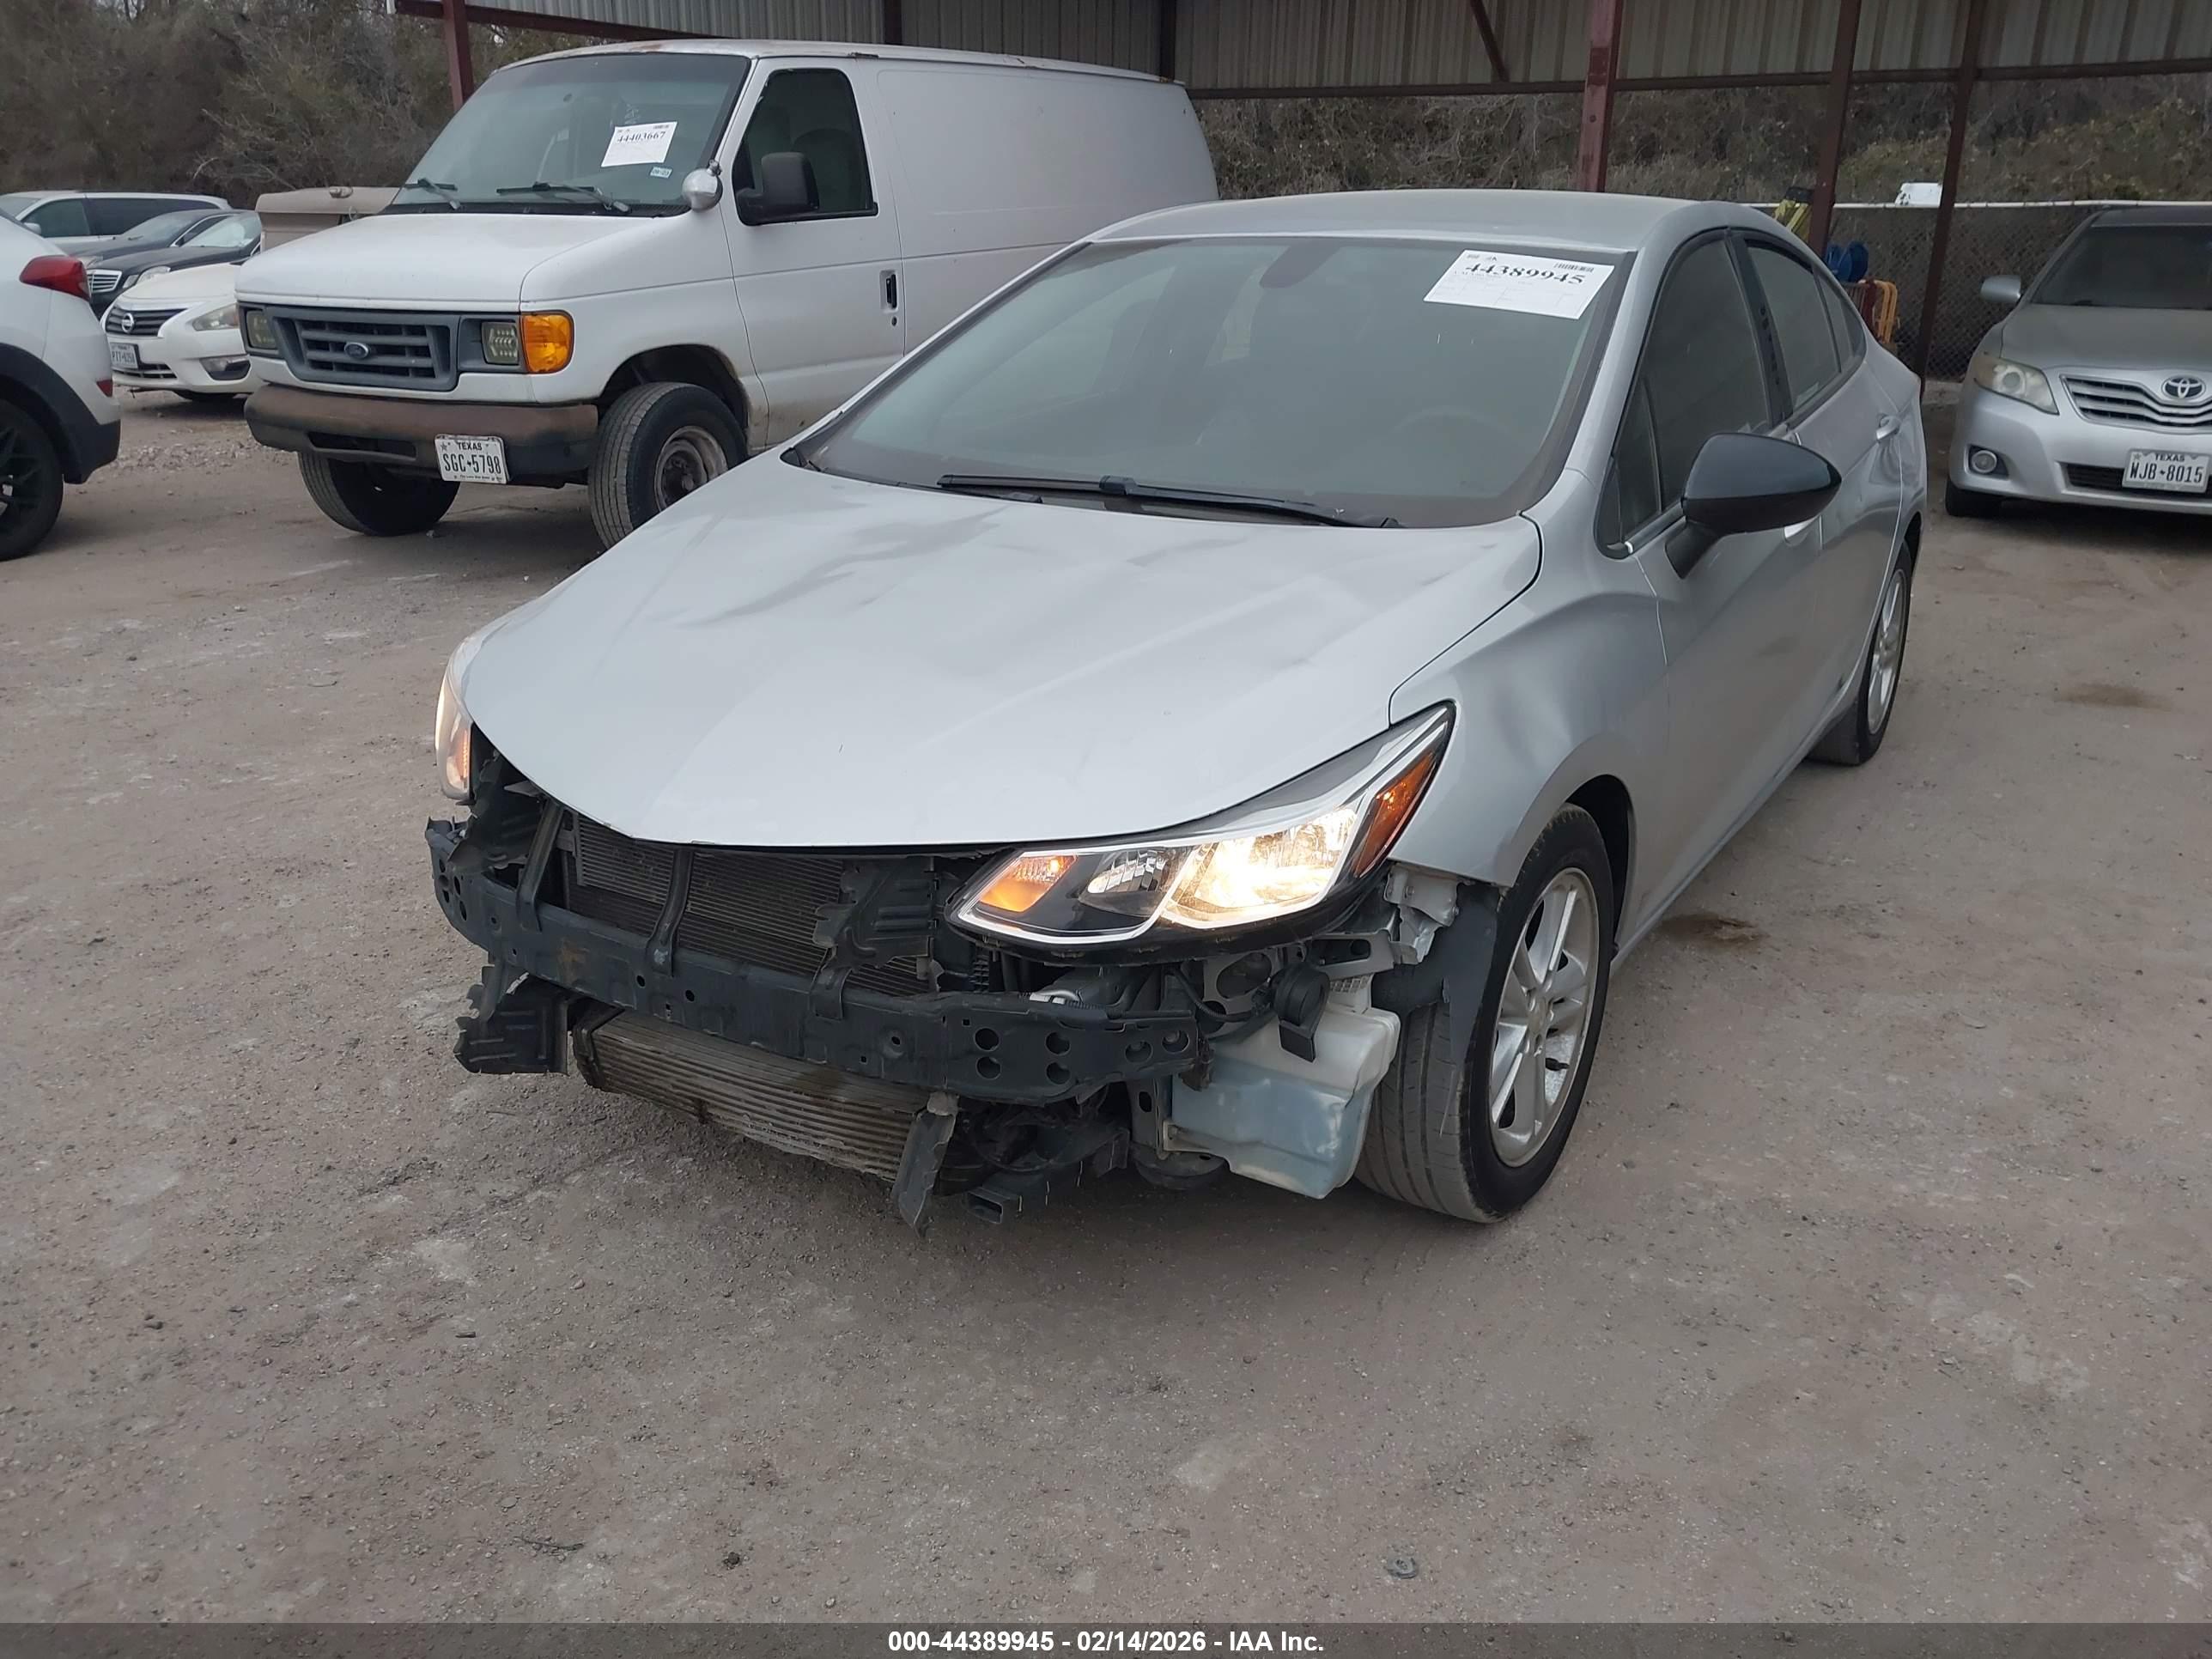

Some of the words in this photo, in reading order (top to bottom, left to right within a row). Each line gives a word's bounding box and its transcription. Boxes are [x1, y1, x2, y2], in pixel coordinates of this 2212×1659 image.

[617, 131, 666, 143] 44403667
[1465, 262, 1586, 285] 44389945
[458, 441, 482, 451] TEXAS
[2155, 453, 2185, 462] TEXAS
